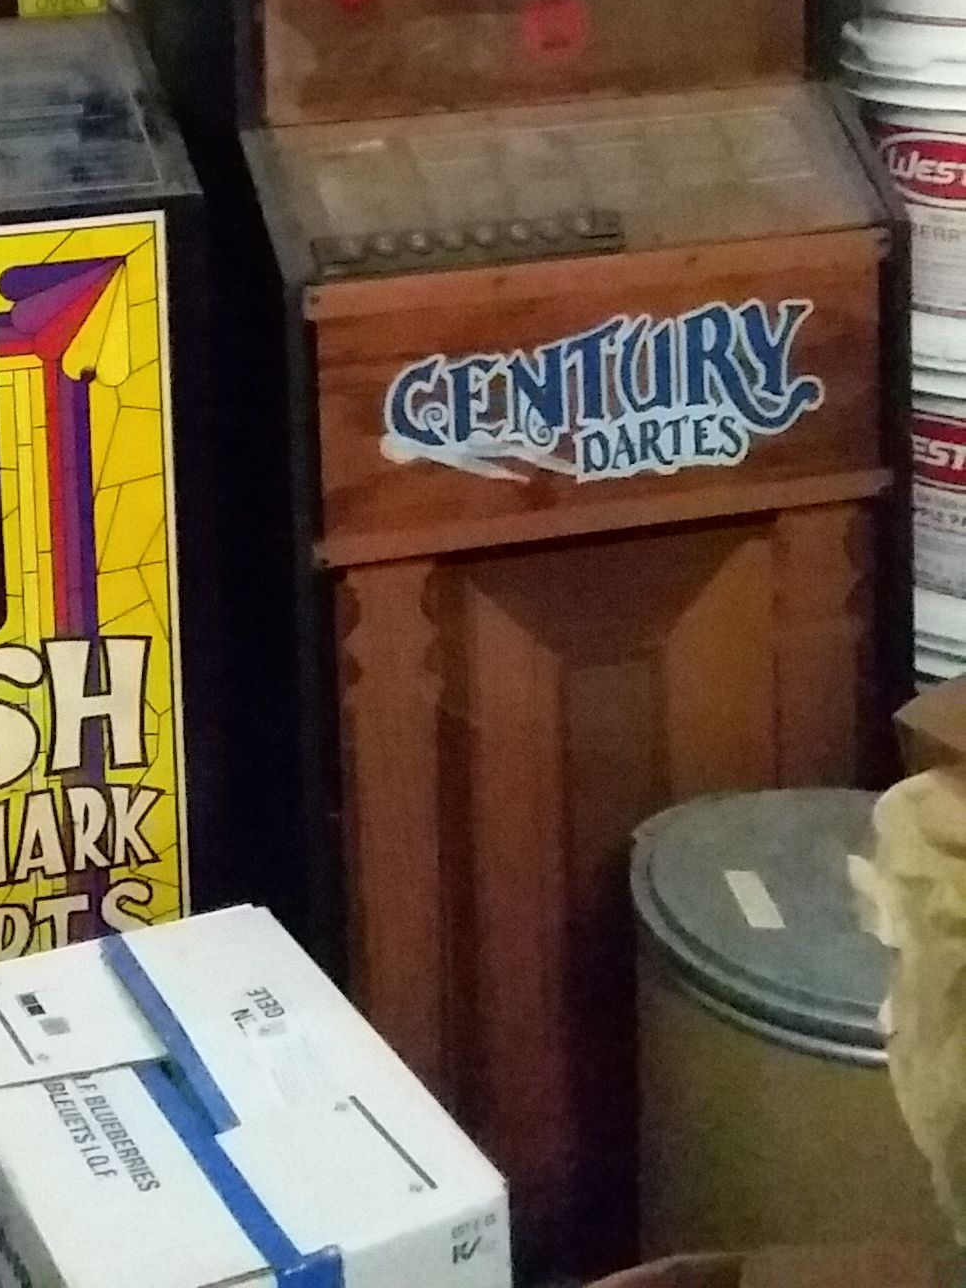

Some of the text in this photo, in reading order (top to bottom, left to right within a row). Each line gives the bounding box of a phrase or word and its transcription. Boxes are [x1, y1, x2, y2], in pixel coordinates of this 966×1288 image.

[388, 300, 823, 448] CENTURY
[580, 413, 743, 473] DARTES
[911, 433, 966, 471] EST
[83, 1095, 160, 1192] BLUEBERRIES
